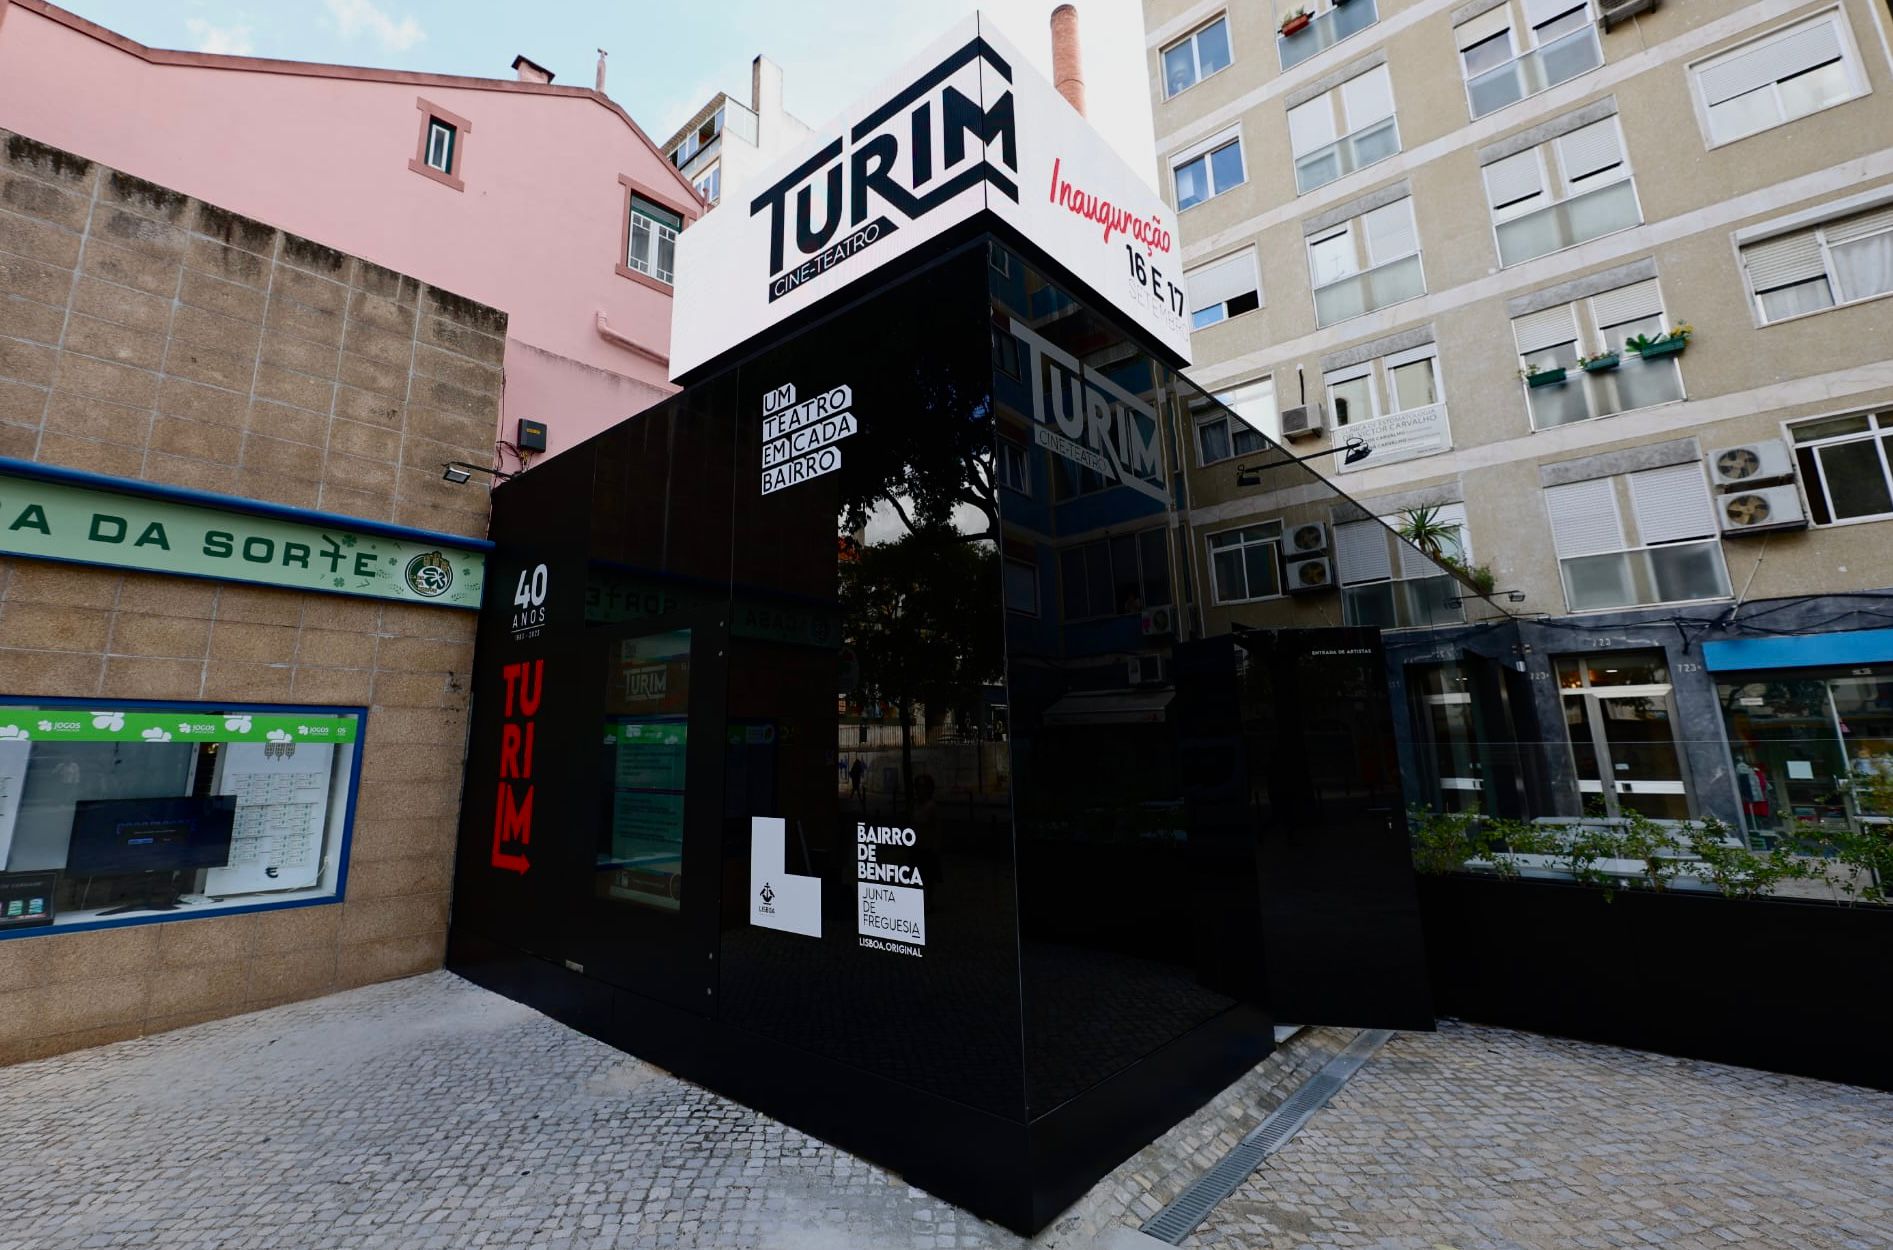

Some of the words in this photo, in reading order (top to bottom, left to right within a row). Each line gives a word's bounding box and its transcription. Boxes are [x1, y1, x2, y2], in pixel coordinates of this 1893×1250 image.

[750, 76, 1019, 278] TURIM
[1050, 158, 1172, 257] Inauguração
[773, 223, 881, 298] CINE-TEATRO
[1126, 244, 1147, 286] 16
[1151, 266, 1165, 302] E
[1167, 281, 1184, 317] 17
[764, 384, 792, 413] UM
[764, 388, 847, 438] TEATRO
[1009, 317, 1164, 484] TURIM
[763, 440, 787, 466] EM
[793, 415, 852, 452] CADA
[1389, 415, 1437, 431] CARVALHO
[763, 450, 836, 493] BAIRRO
[1, 504, 51, 535] A
[88, 512, 170, 551] DA
[202, 529, 378, 578] SORTE
[514, 563, 548, 609] 40
[512, 607, 545, 629] ANOS
[54, 722, 81, 730] JOGOS
[857, 823, 917, 847] BAIRRO
[857, 844, 877, 862] DE
[857, 862, 923, 886] BENFICA
[862, 887, 896, 903] JUNTA
[863, 901, 876, 914] DE
[863, 913, 921, 937] FREGUESIA
